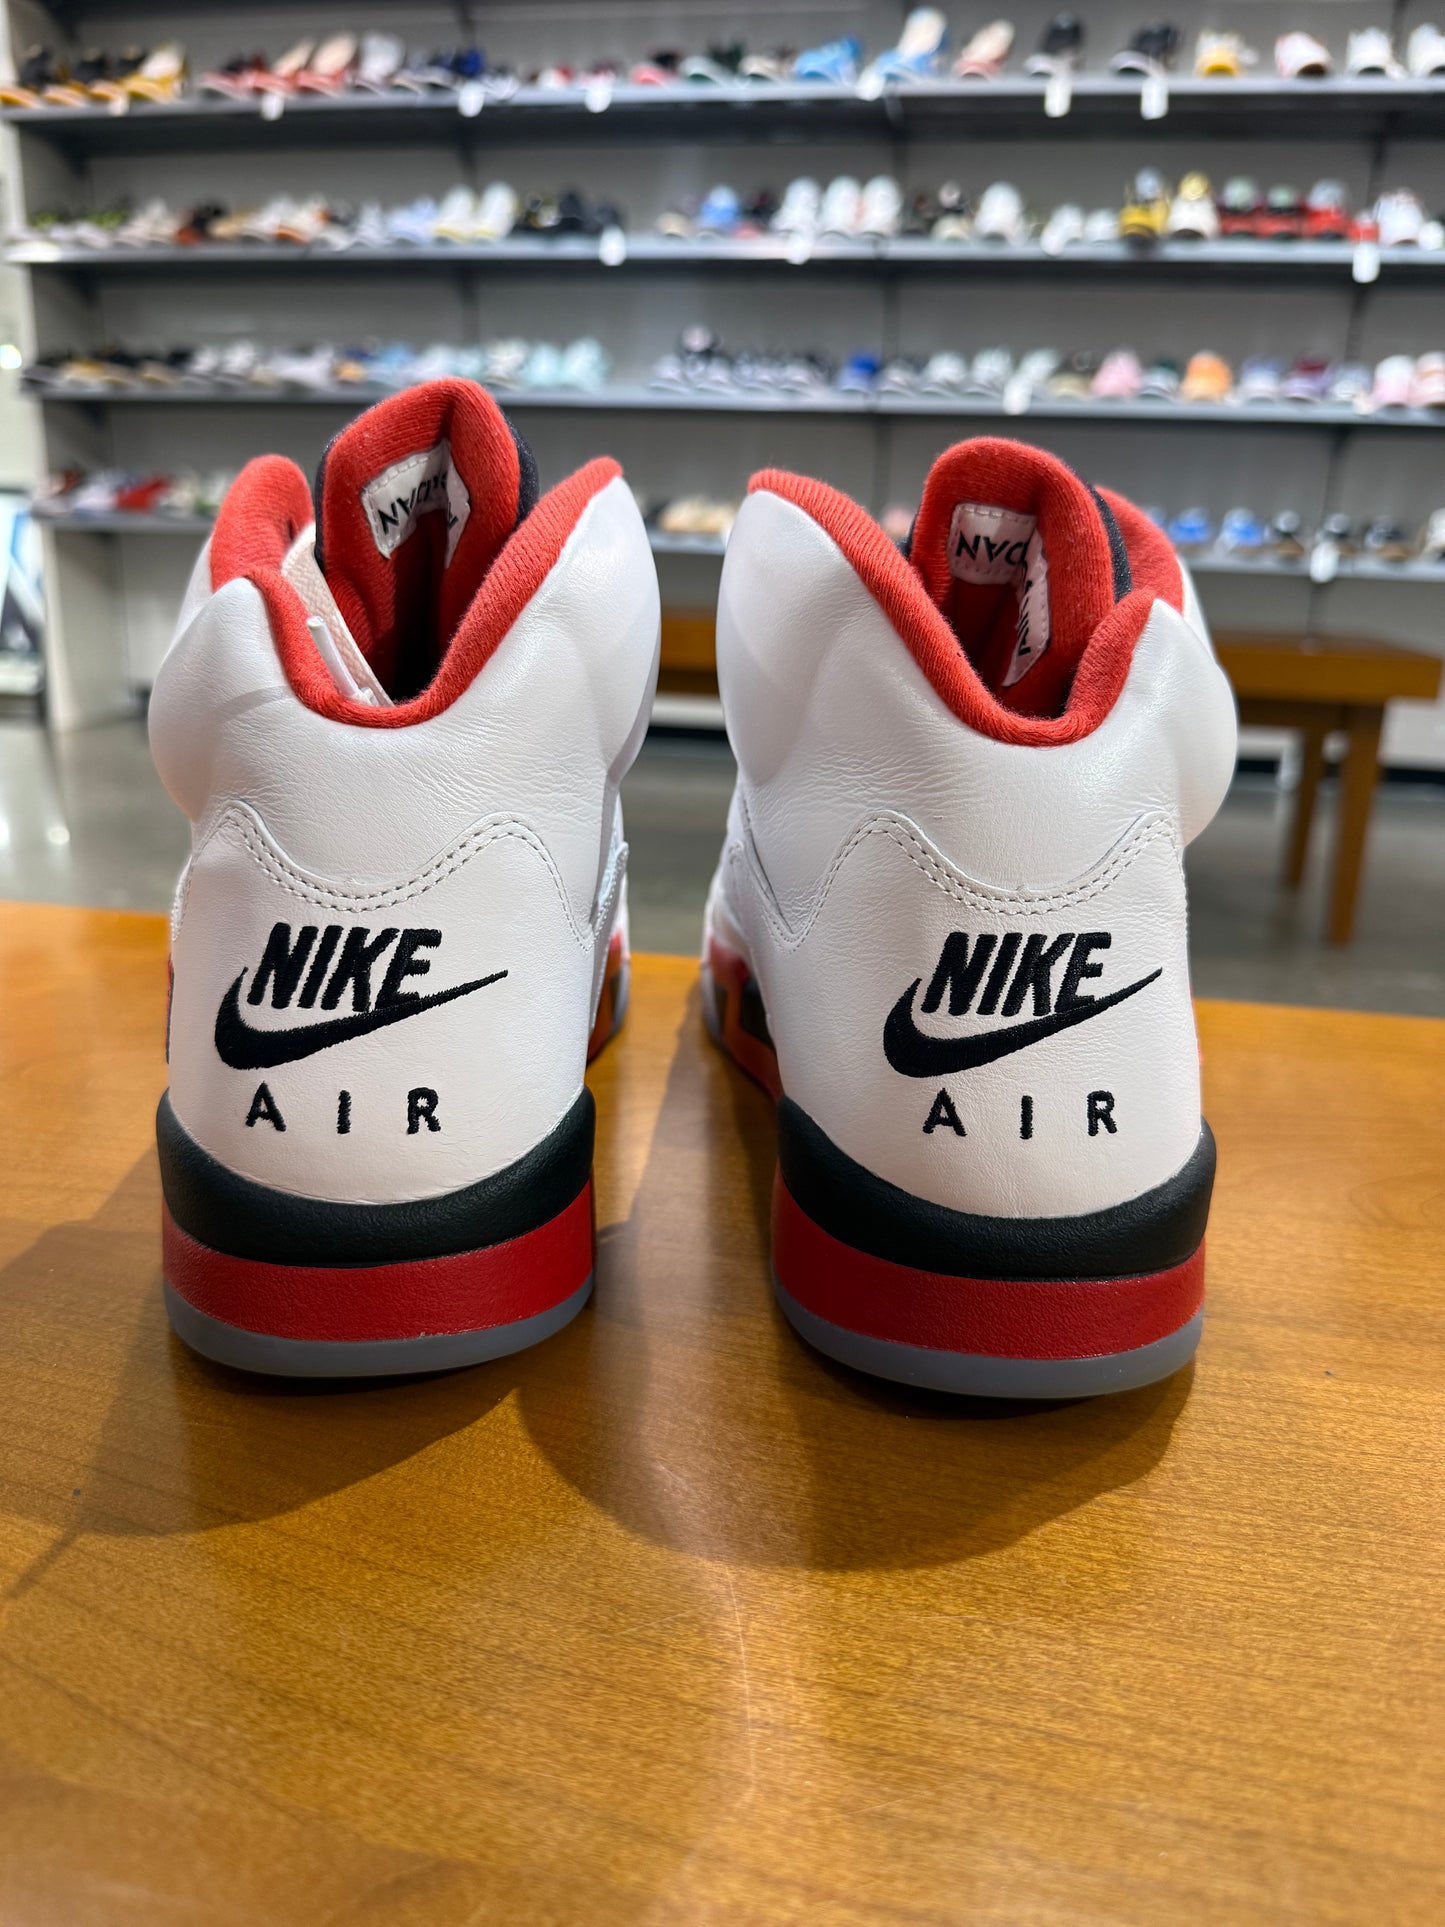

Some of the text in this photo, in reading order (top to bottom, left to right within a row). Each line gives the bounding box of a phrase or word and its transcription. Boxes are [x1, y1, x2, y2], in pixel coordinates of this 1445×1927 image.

[247, 922, 442, 1012] NIKE
[921, 932, 1112, 1017] NIKE
[245, 1081, 441, 1135] AIR
[922, 1087, 1118, 1140] AIR
